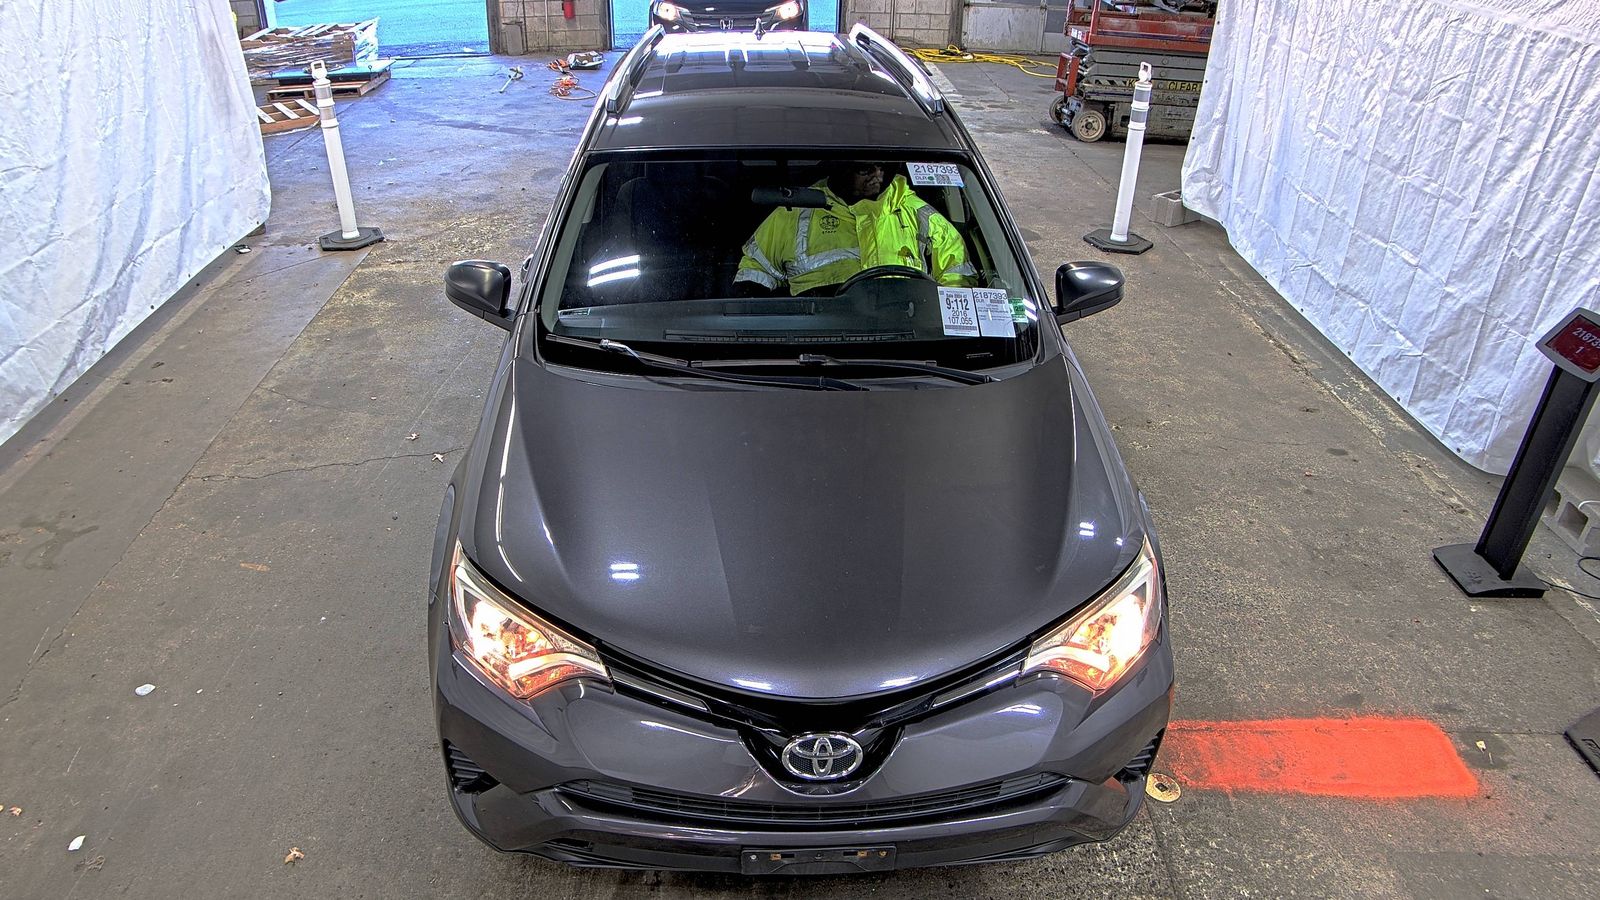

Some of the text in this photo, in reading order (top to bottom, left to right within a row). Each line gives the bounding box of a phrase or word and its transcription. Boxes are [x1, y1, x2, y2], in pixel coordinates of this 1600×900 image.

[913, 165, 959, 174] 2187393
[973, 291, 1007, 300] 2187393
[946, 298, 970, 310] 9:112
[1575, 346, 1585, 354] 1
